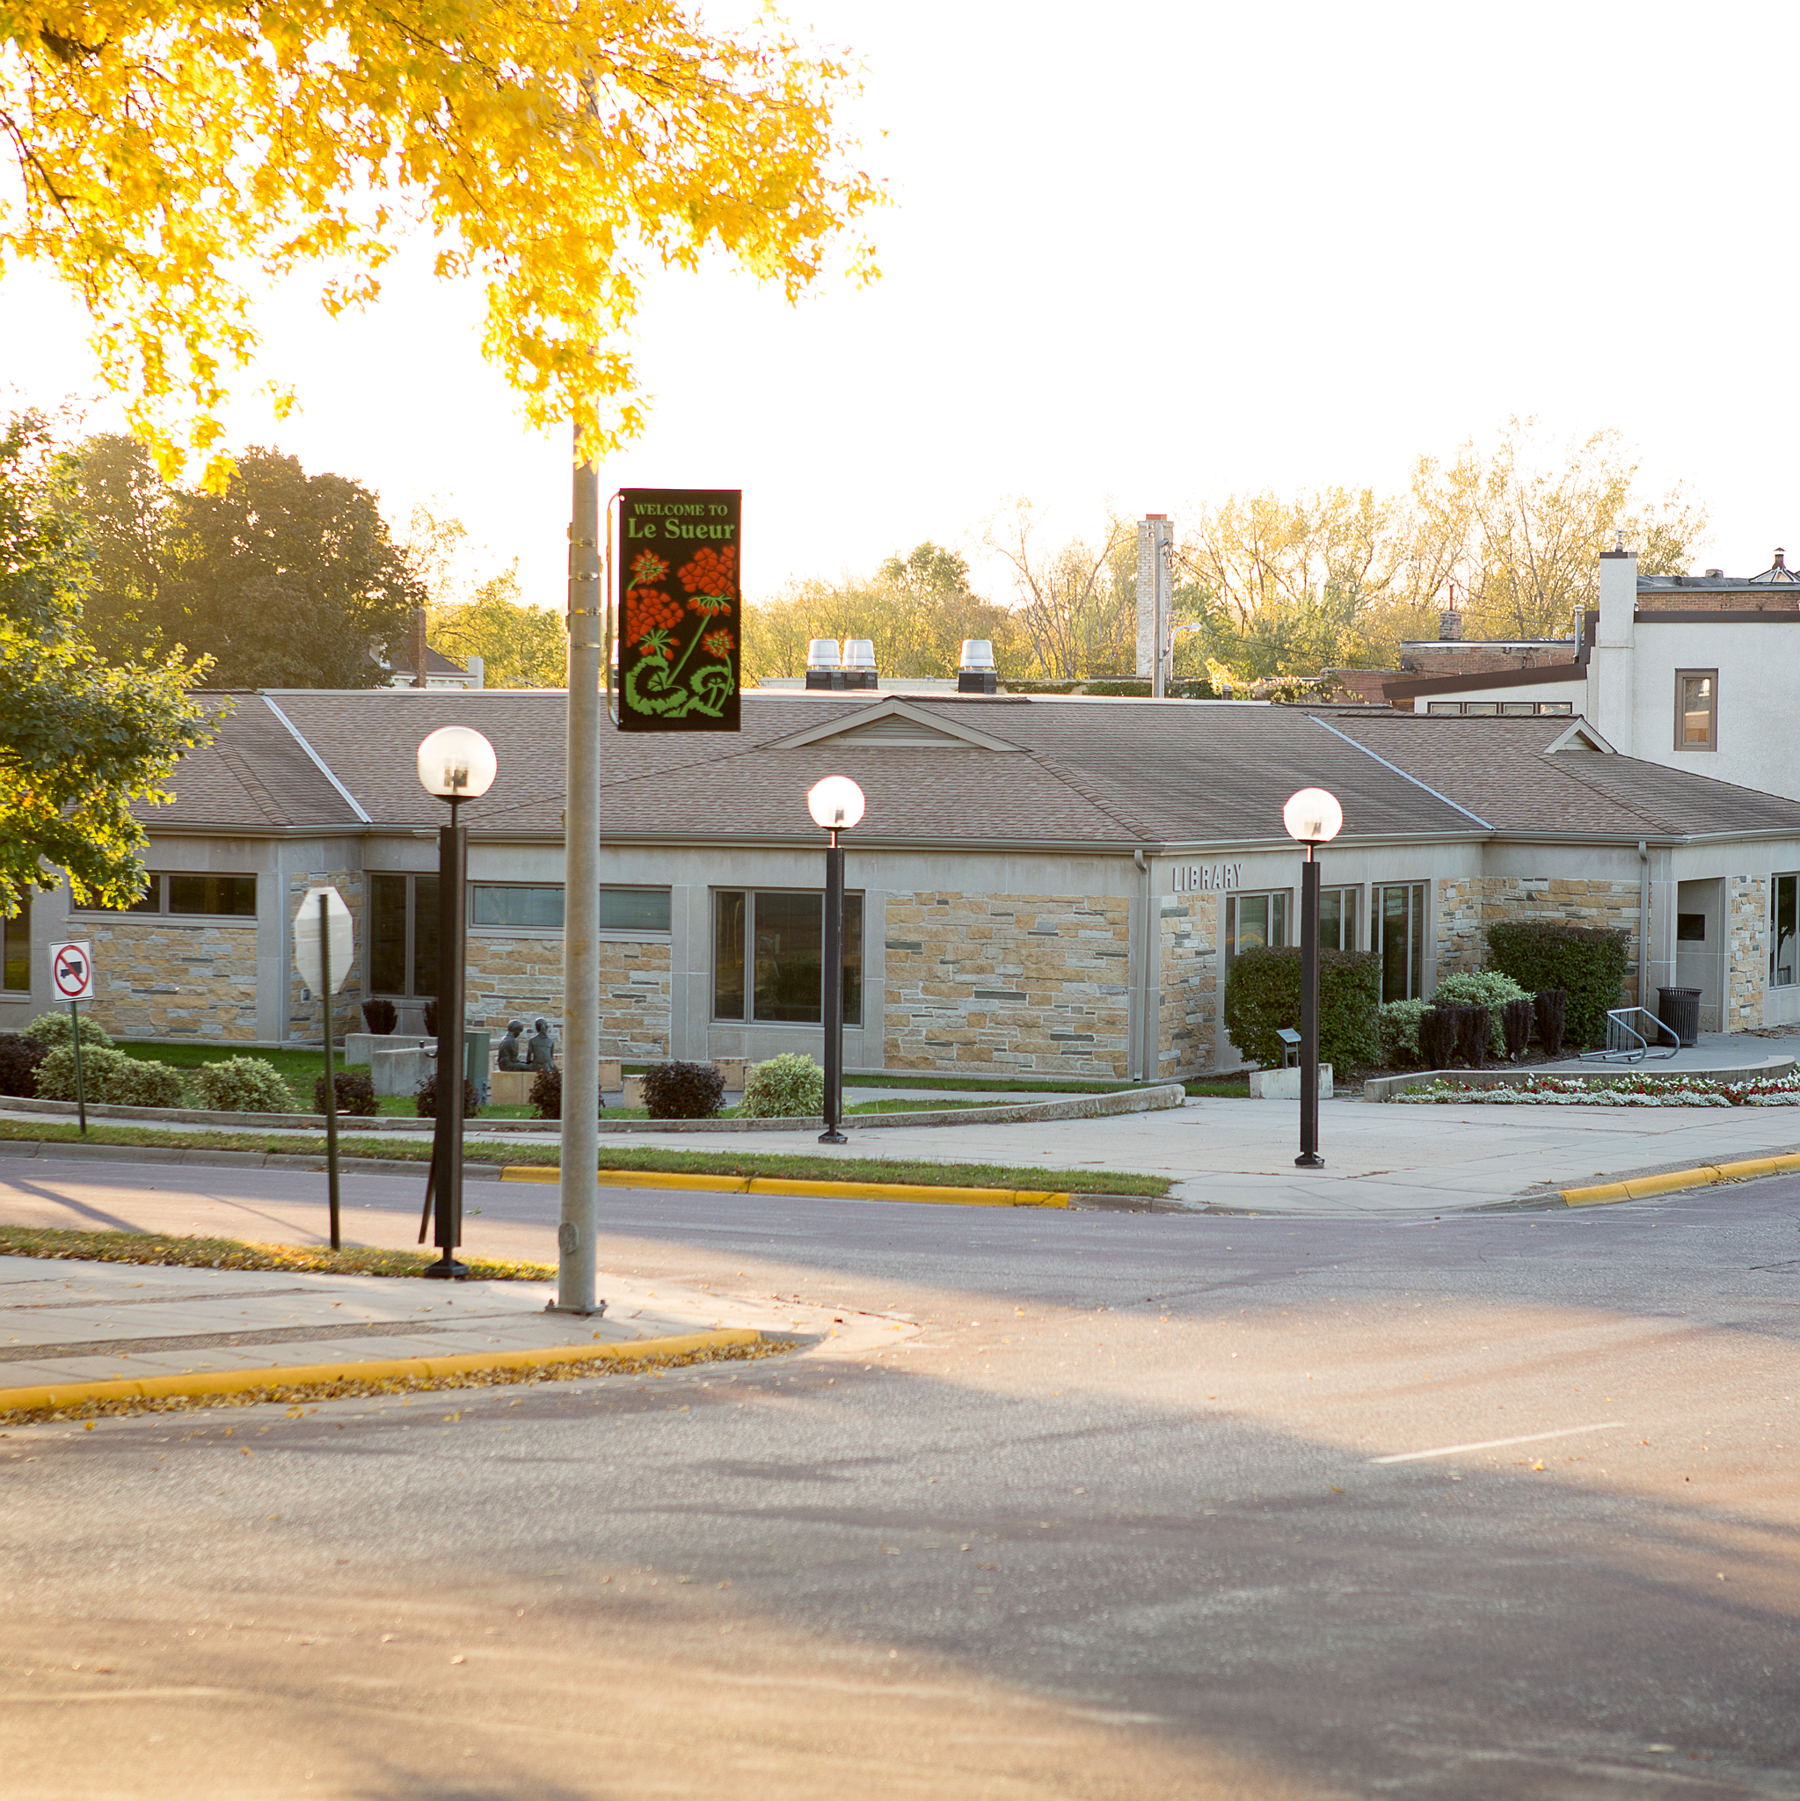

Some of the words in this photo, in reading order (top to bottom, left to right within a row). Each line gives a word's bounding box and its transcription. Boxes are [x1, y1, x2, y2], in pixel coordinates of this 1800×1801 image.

[634, 503, 705, 516] WELCOME
[708, 504, 728, 516] TO
[628, 518, 657, 538] Le
[665, 518, 735, 539] Sueur
[1173, 864, 1243, 892] LIBRARY
